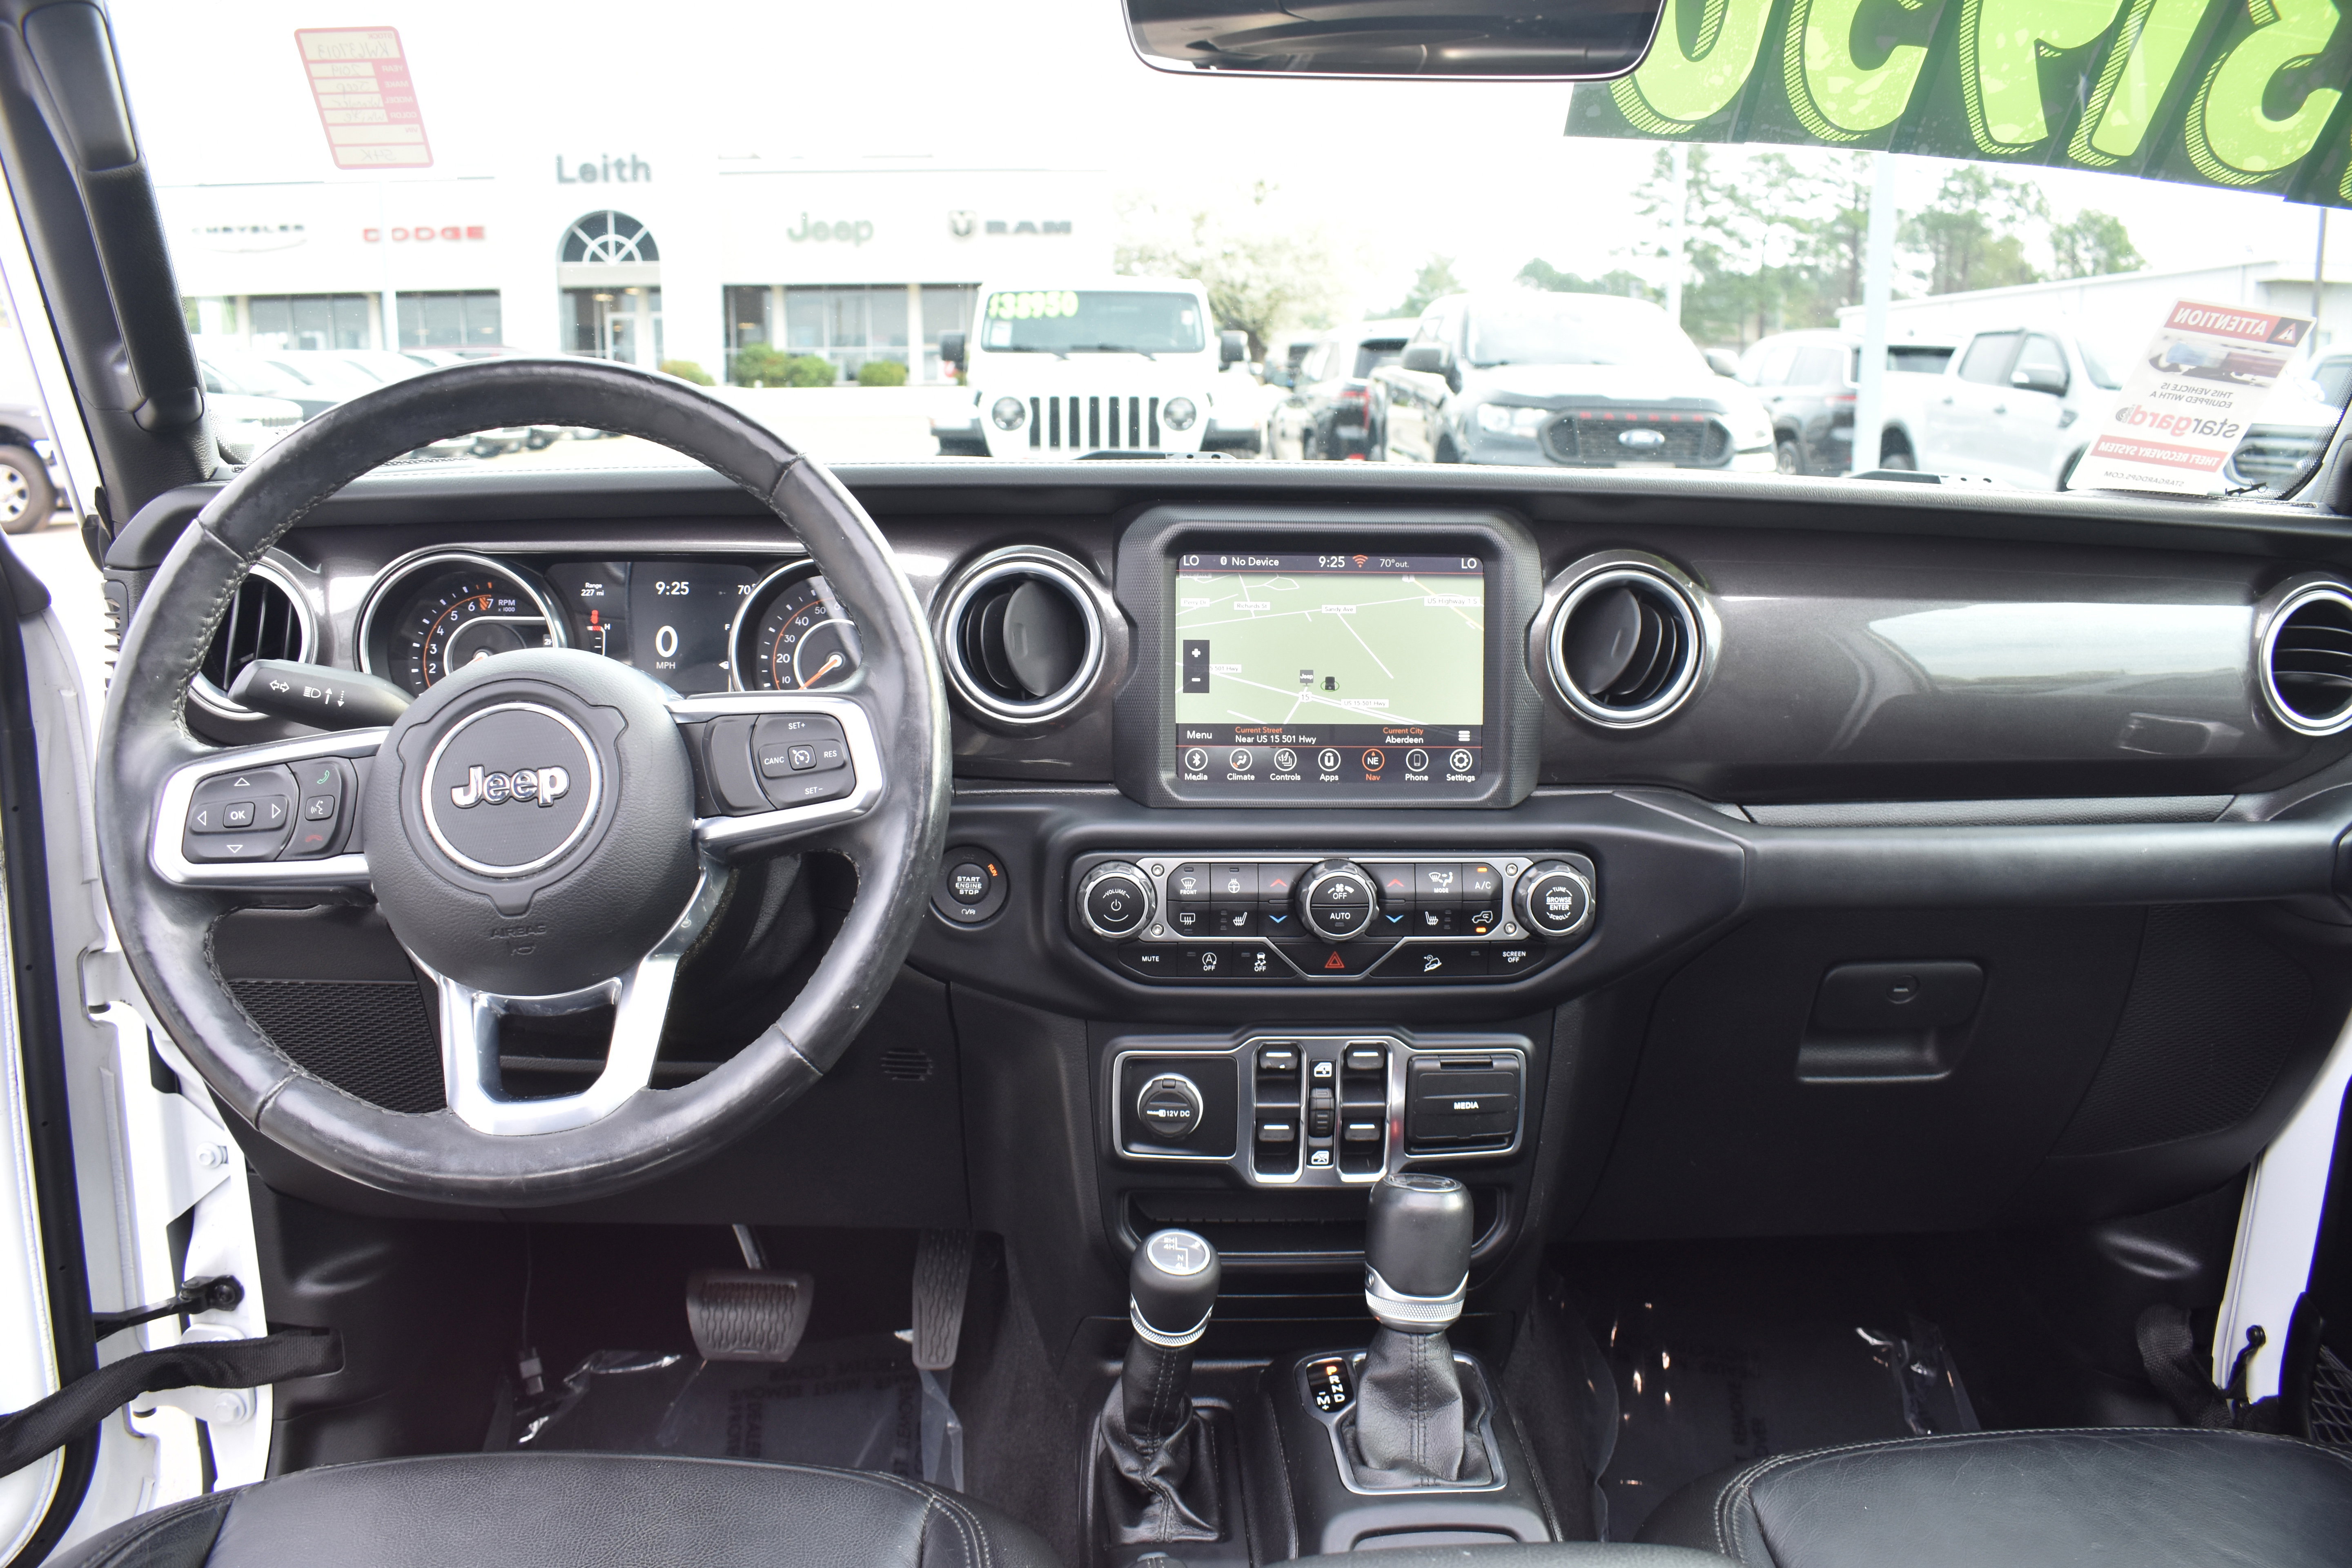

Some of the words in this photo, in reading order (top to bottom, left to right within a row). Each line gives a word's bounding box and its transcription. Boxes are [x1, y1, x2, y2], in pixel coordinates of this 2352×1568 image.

[556, 153, 653, 184] Leith
[786, 212, 874, 247] Jeep
[984, 220, 1073, 236] RAM
[362, 225, 487, 243] DODGE
[1183, 555, 1199, 566] LO
[1232, 557, 1246, 566] No
[1248, 557, 1279, 566] Device
[1319, 556, 1345, 567] 9:25
[1461, 558, 1477, 569] LO
[655, 581, 690, 595] 9:25
[468, 601, 475, 612] 6
[486, 598, 494, 609] 7
[450, 610, 458, 621] 5
[815, 606, 826, 615] 50
[795, 617, 809, 626] 40
[436, 625, 444, 635] 4
[655, 625, 678, 658] 0
[784, 635, 795, 643] 30
[429, 644, 437, 654] 3
[776, 653, 790, 663] 20
[428, 663, 437, 674] 2
[656, 661, 676, 670] MPH
[1187, 730, 1213, 739] Menu
[1410, 727, 1424, 735] City
[1256, 735, 1268, 743] US
[1270, 735, 1280, 743] 15
[1281, 735, 1296, 743] 501
[1298, 735, 1317, 744] Hwy
[1385, 736, 1424, 744] Aberdeen
[764, 756, 784, 765] CANC
[1367, 757, 1379, 766] NE
[1227, 773, 1255, 781] Climate
[1319, 773, 1339, 782] Apps
[1405, 773, 1429, 782] Phone
[1446, 774, 1476, 782] Settings
[451, 765, 570, 808] Jeep
[230, 810, 246, 820] OK
[987, 864, 998, 877] RUN
[1474, 880, 1492, 891] A/C
[1105, 889, 1127, 897] VOLUME
[490, 924, 548, 940] AIRBAG
[1453, 1101, 1479, 1110] MEDIA
[1326, 1365, 1337, 1376] P
[1329, 1375, 1341, 1384] R
[1331, 1383, 1343, 1393] N
[1316, 1395, 1331, 1405] M
[1334, 1393, 1345, 1403] D
